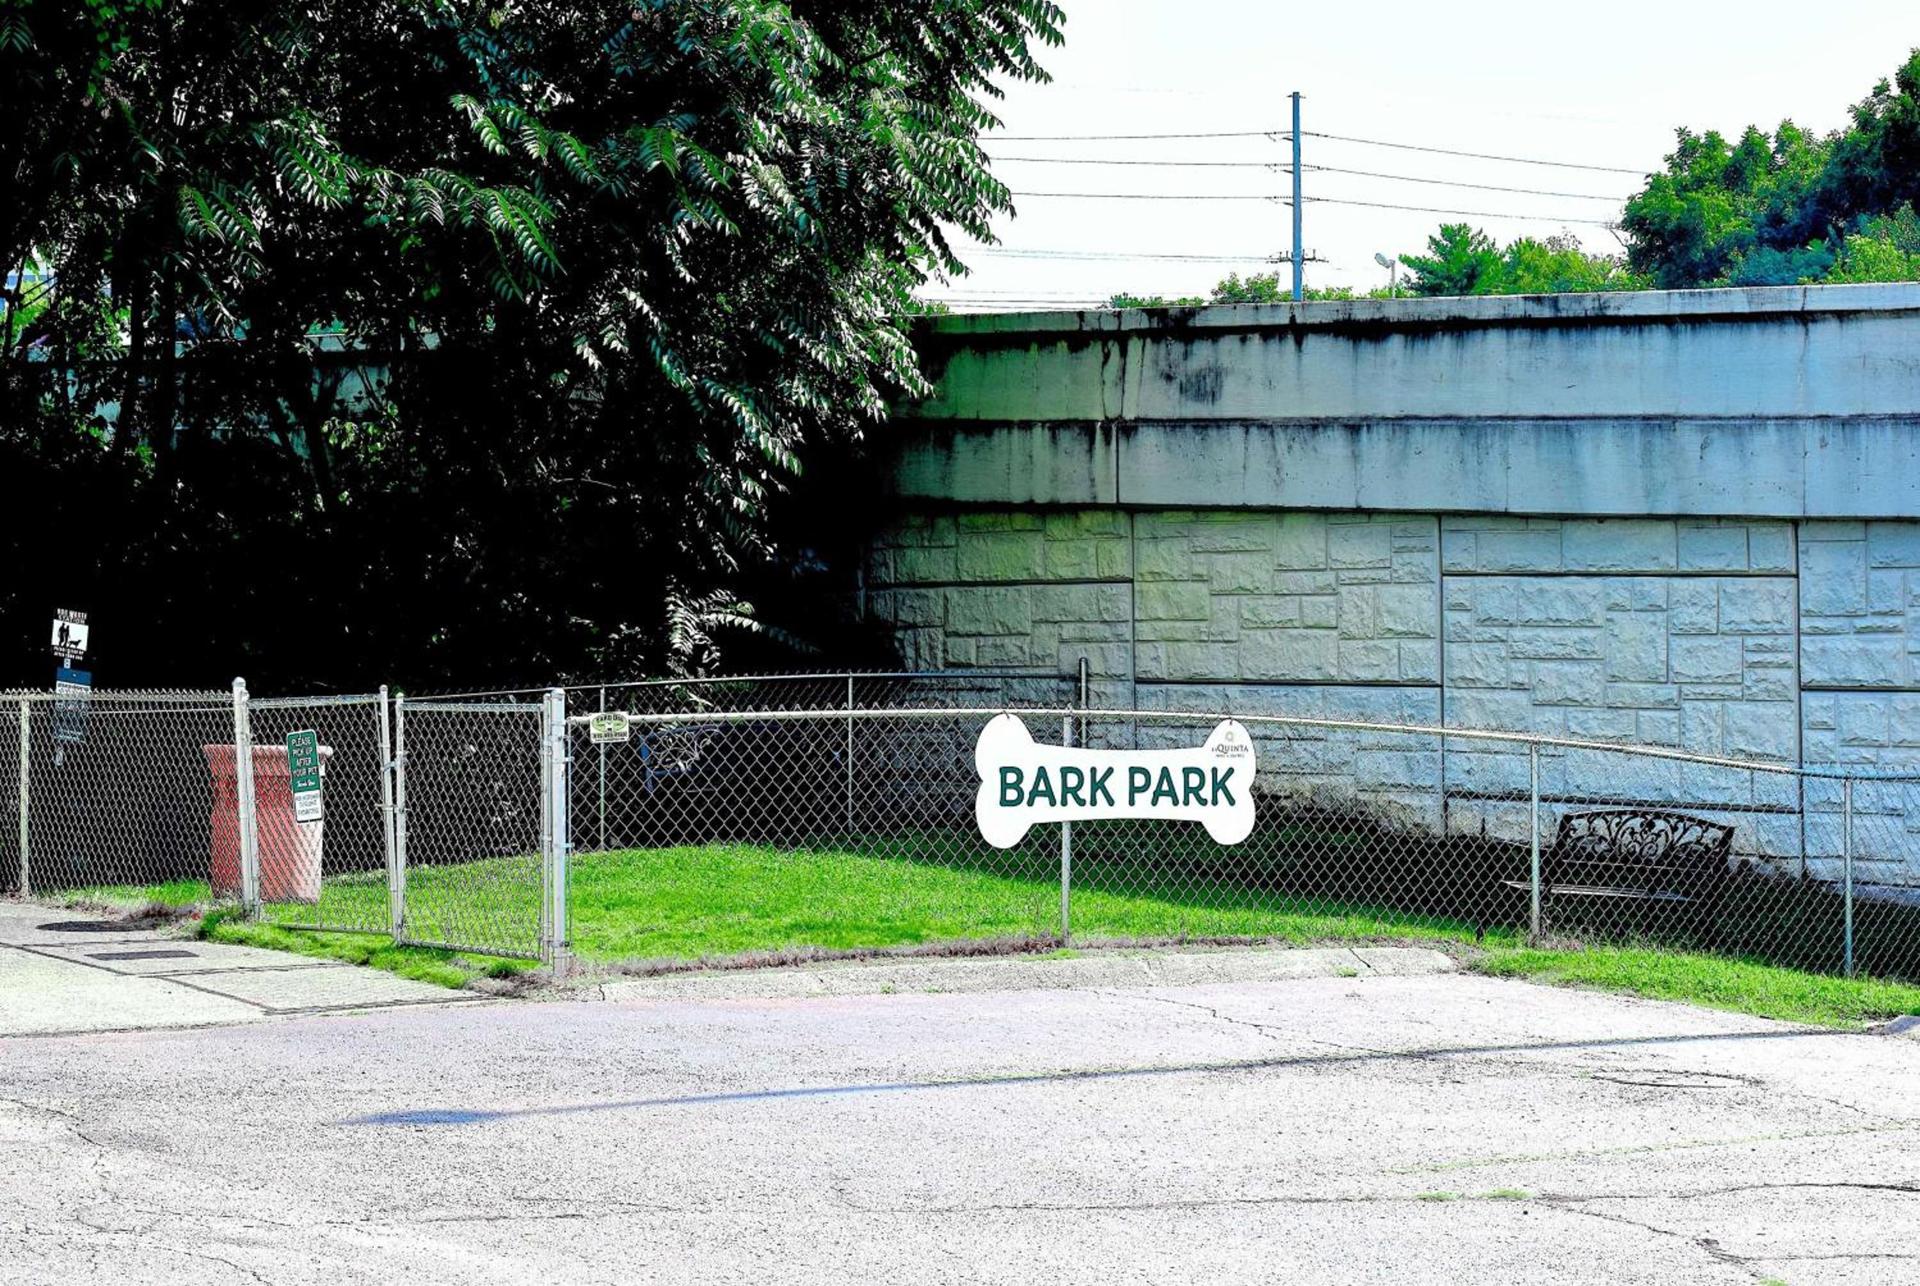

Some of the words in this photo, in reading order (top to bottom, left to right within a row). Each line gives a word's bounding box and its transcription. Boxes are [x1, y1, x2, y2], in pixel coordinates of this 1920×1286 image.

[292, 737, 311, 746] PLEASE
[293, 748, 304, 757] PICK
[305, 747, 313, 755] UP
[297, 757, 311, 766] AFTER
[999, 766, 1115, 807] BARK
[1128, 766, 1236, 807] PARK
